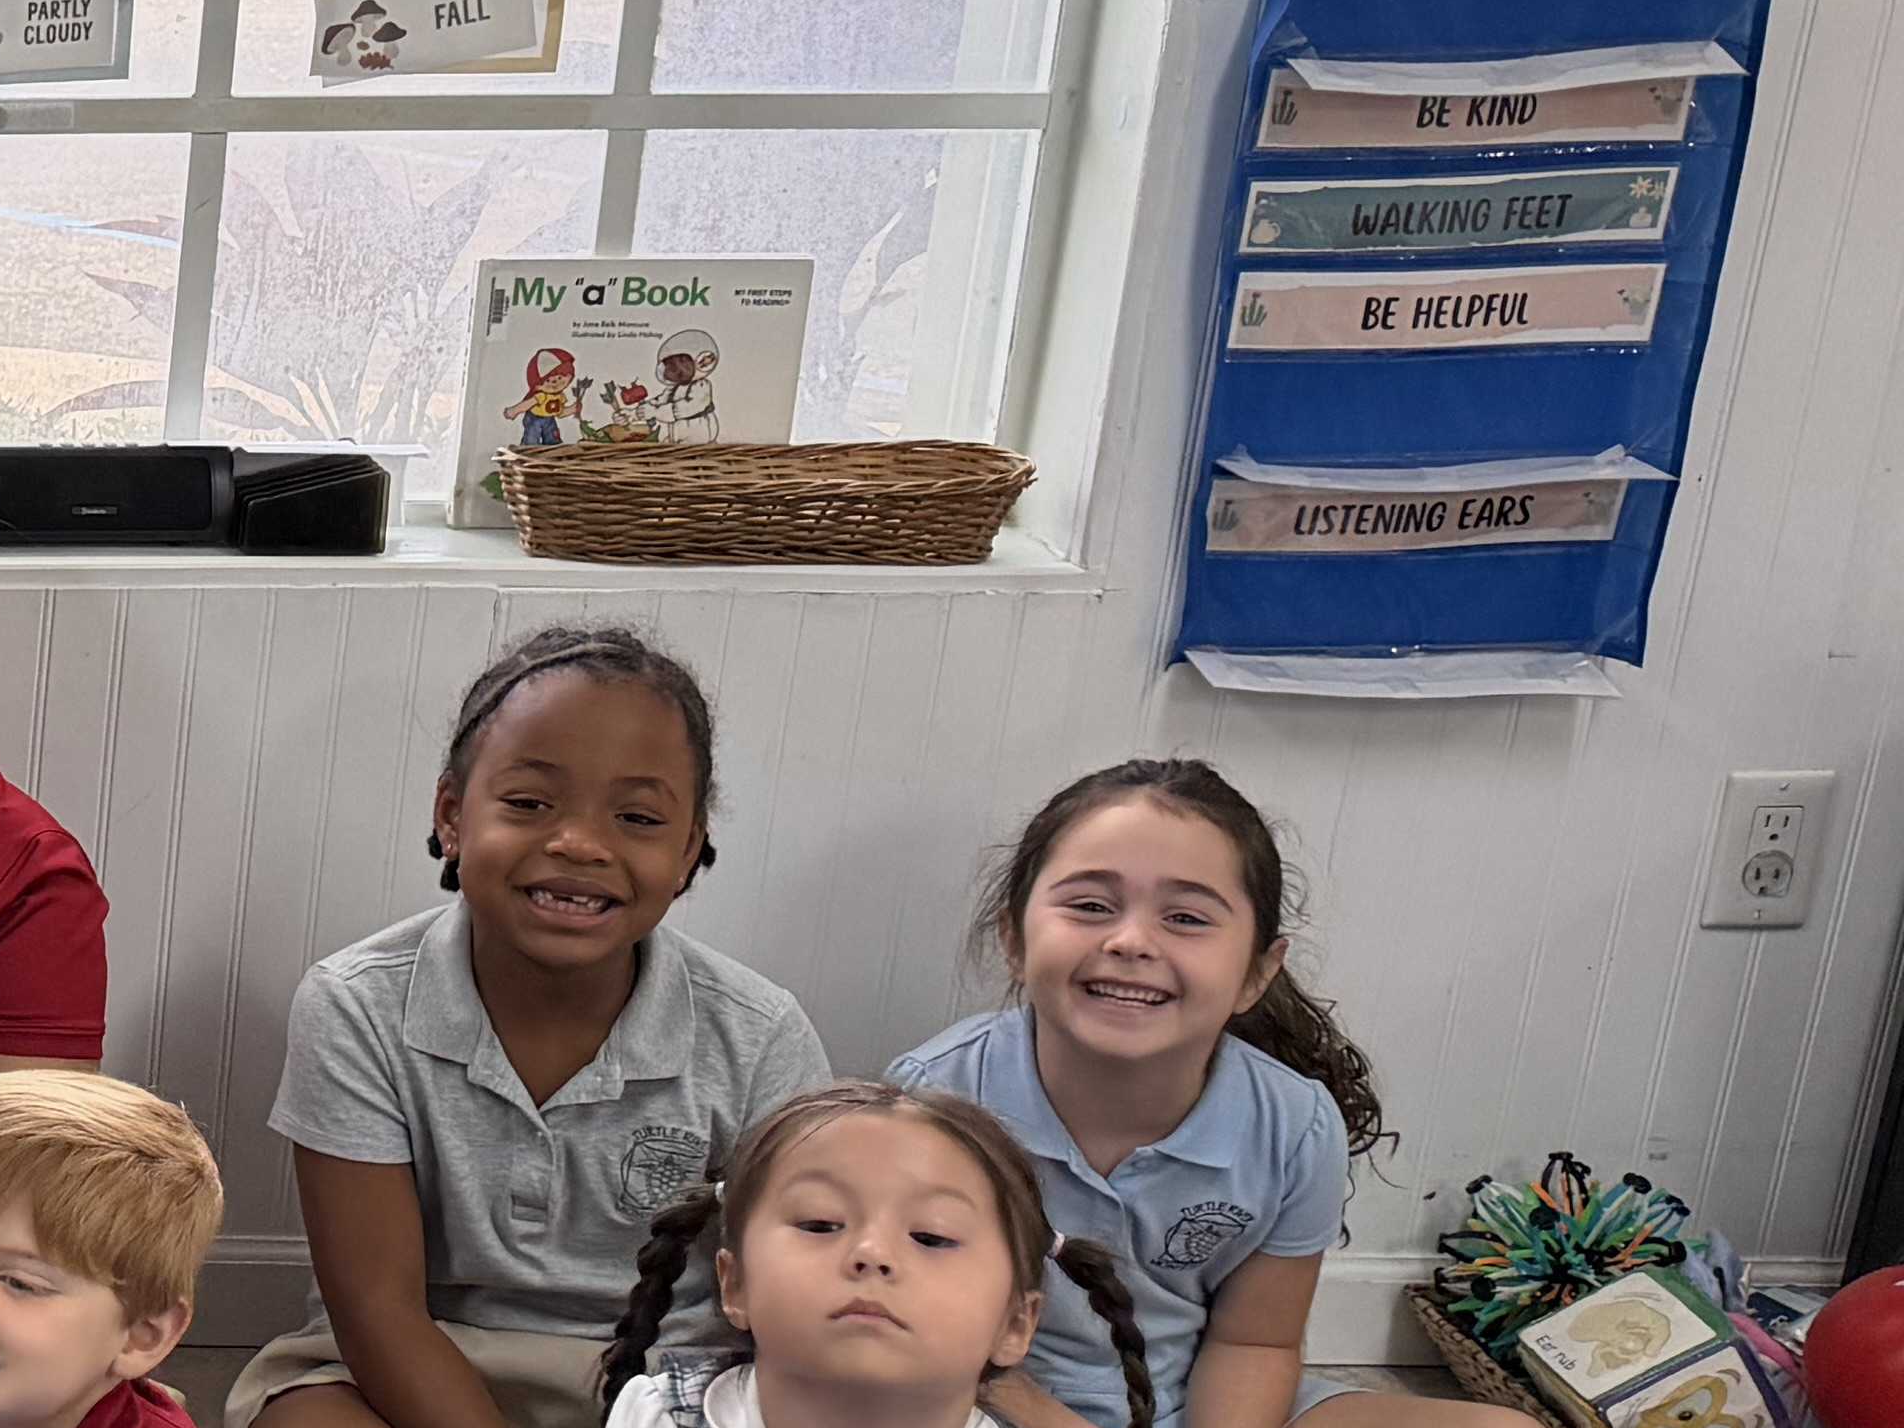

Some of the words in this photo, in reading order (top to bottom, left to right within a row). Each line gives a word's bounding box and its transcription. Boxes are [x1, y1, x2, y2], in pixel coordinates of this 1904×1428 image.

[23, 21, 94, 45] CLOUDY
[1415, 94, 1452, 129] BE
[1465, 93, 1538, 129] KIND
[1351, 197, 1491, 240] WALKING
[1504, 192, 1573, 233] FEET
[512, 277, 567, 312] My
[621, 276, 712, 307] Book
[1360, 294, 1400, 332] BE
[1412, 292, 1530, 330] HELPFUL
[1293, 498, 1446, 537] LISTENING
[1457, 494, 1536, 529] EARS
